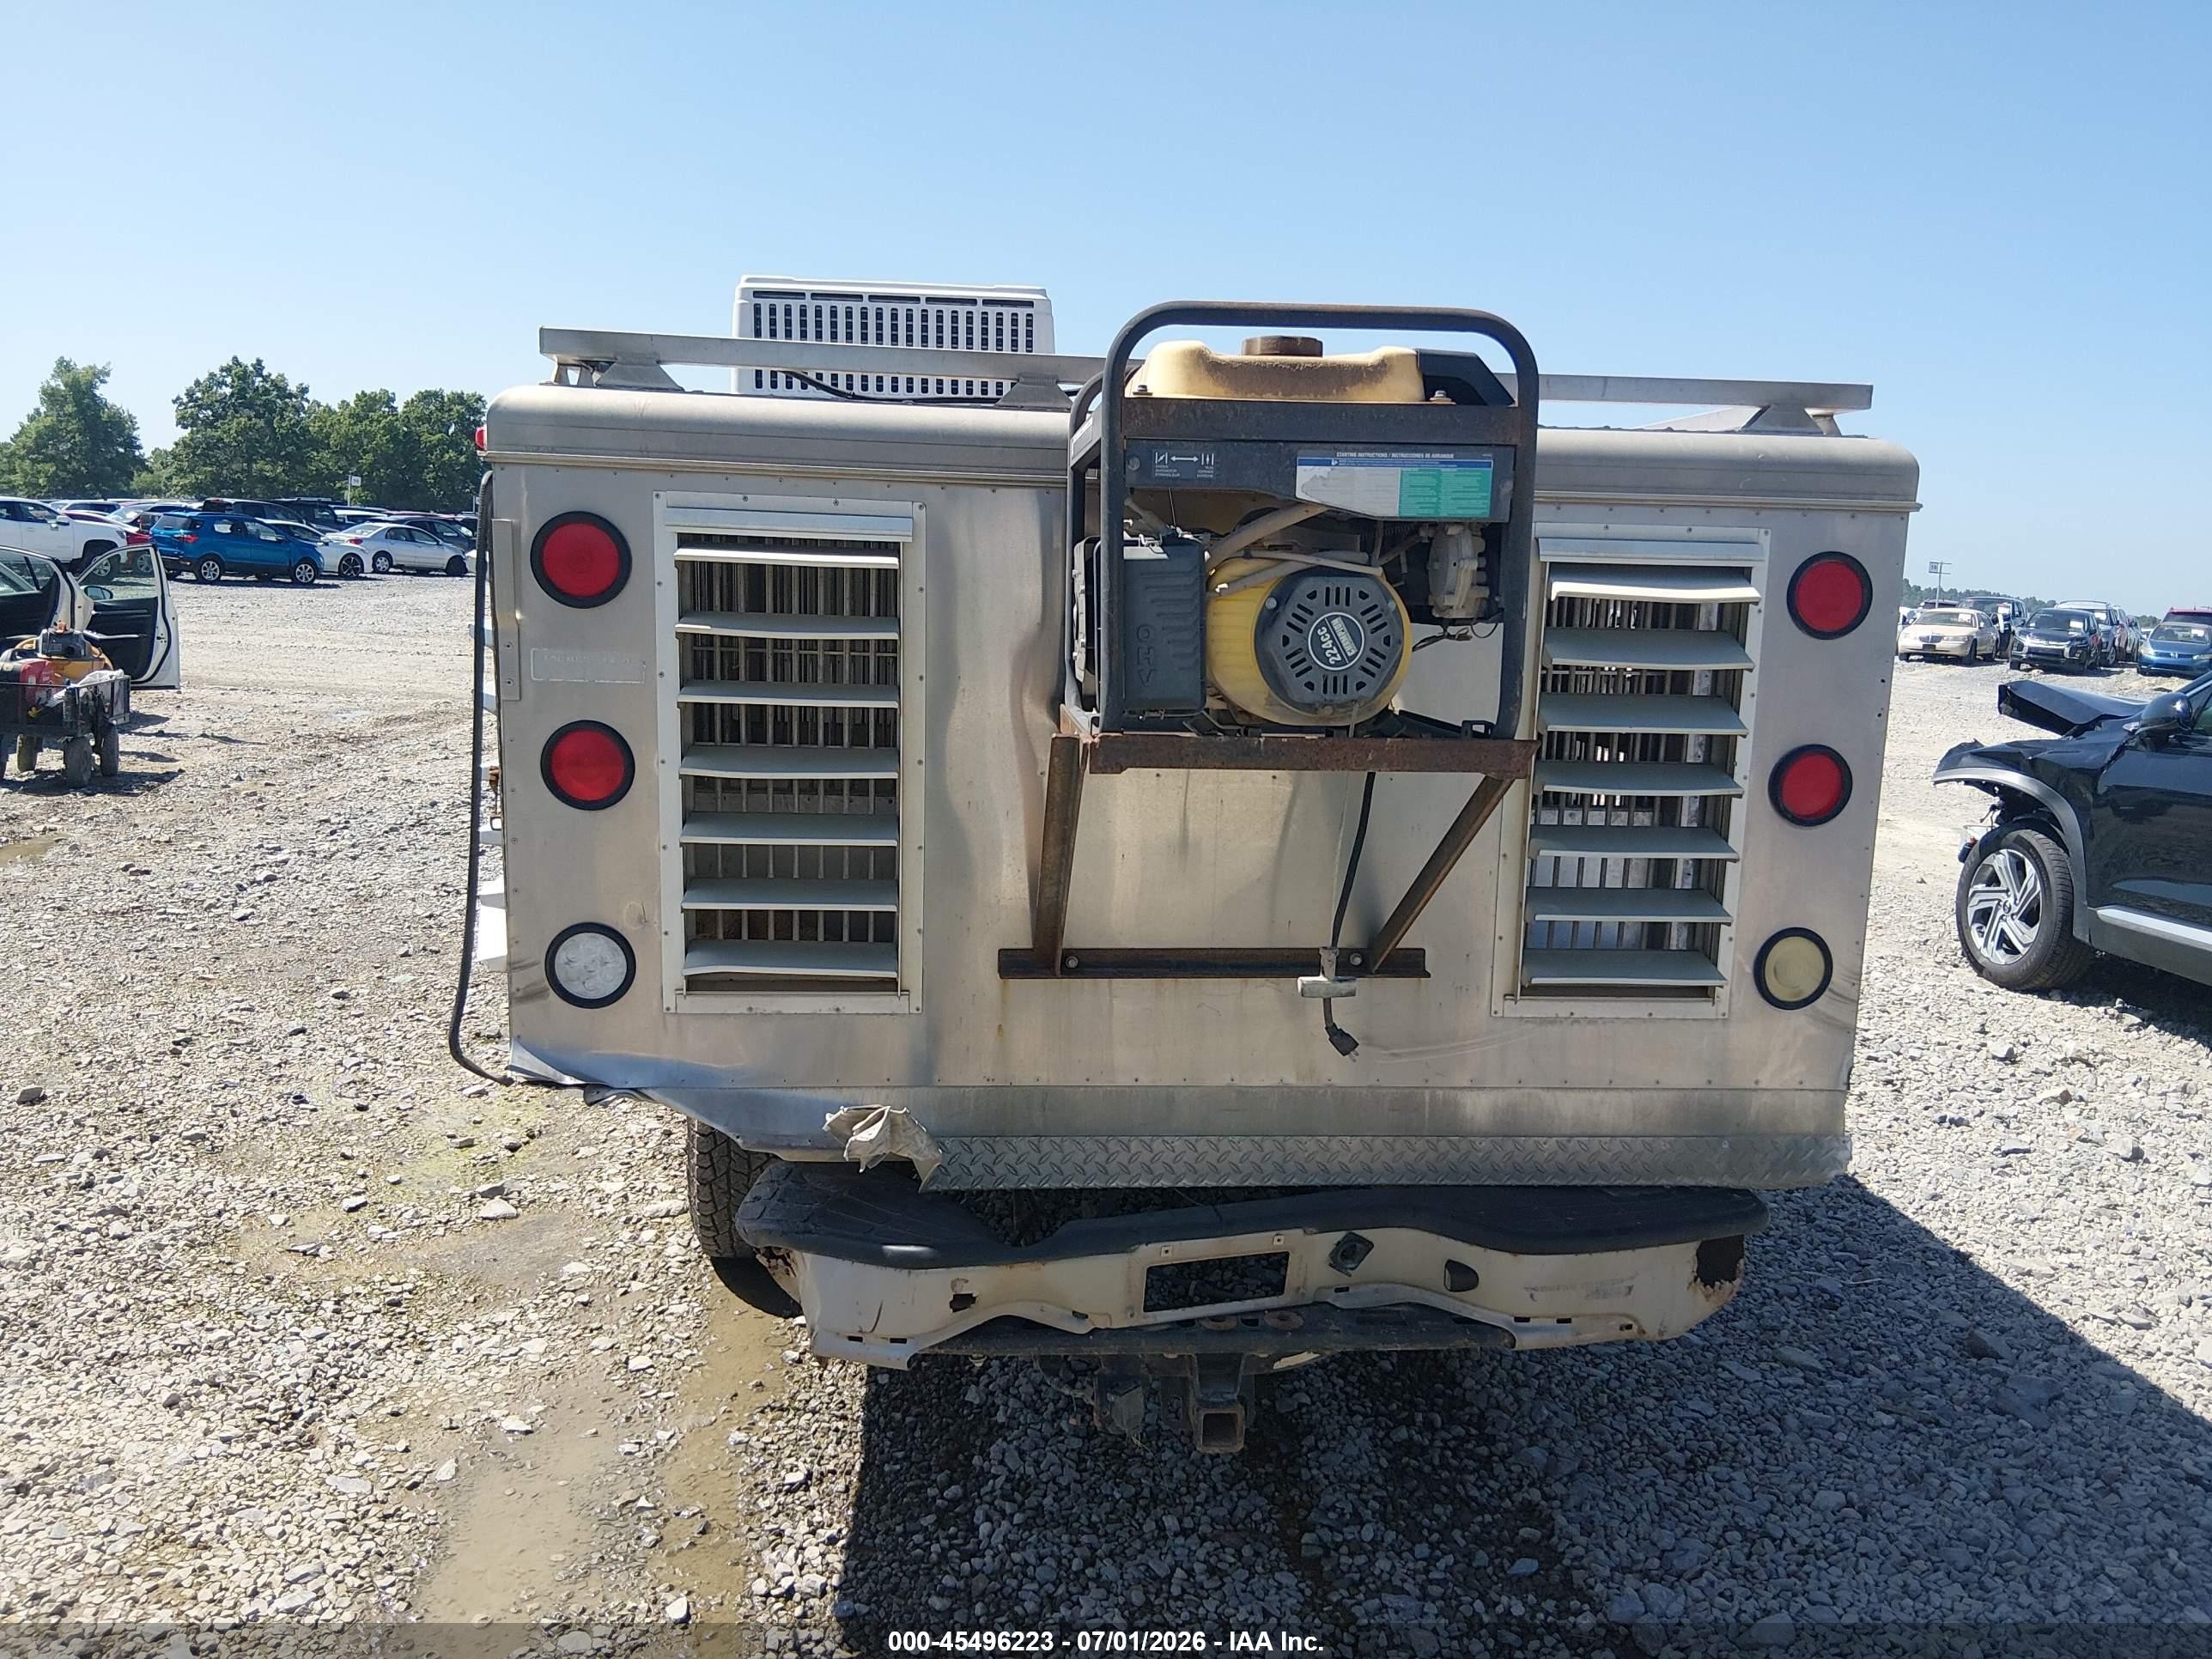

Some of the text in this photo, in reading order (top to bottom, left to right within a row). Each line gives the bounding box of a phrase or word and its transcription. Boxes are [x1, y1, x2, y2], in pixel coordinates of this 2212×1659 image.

[1136, 623, 1155, 688] OHV
[1316, 626, 1342, 665] 224CC
[1331, 616, 1358, 658] CHAMPION
